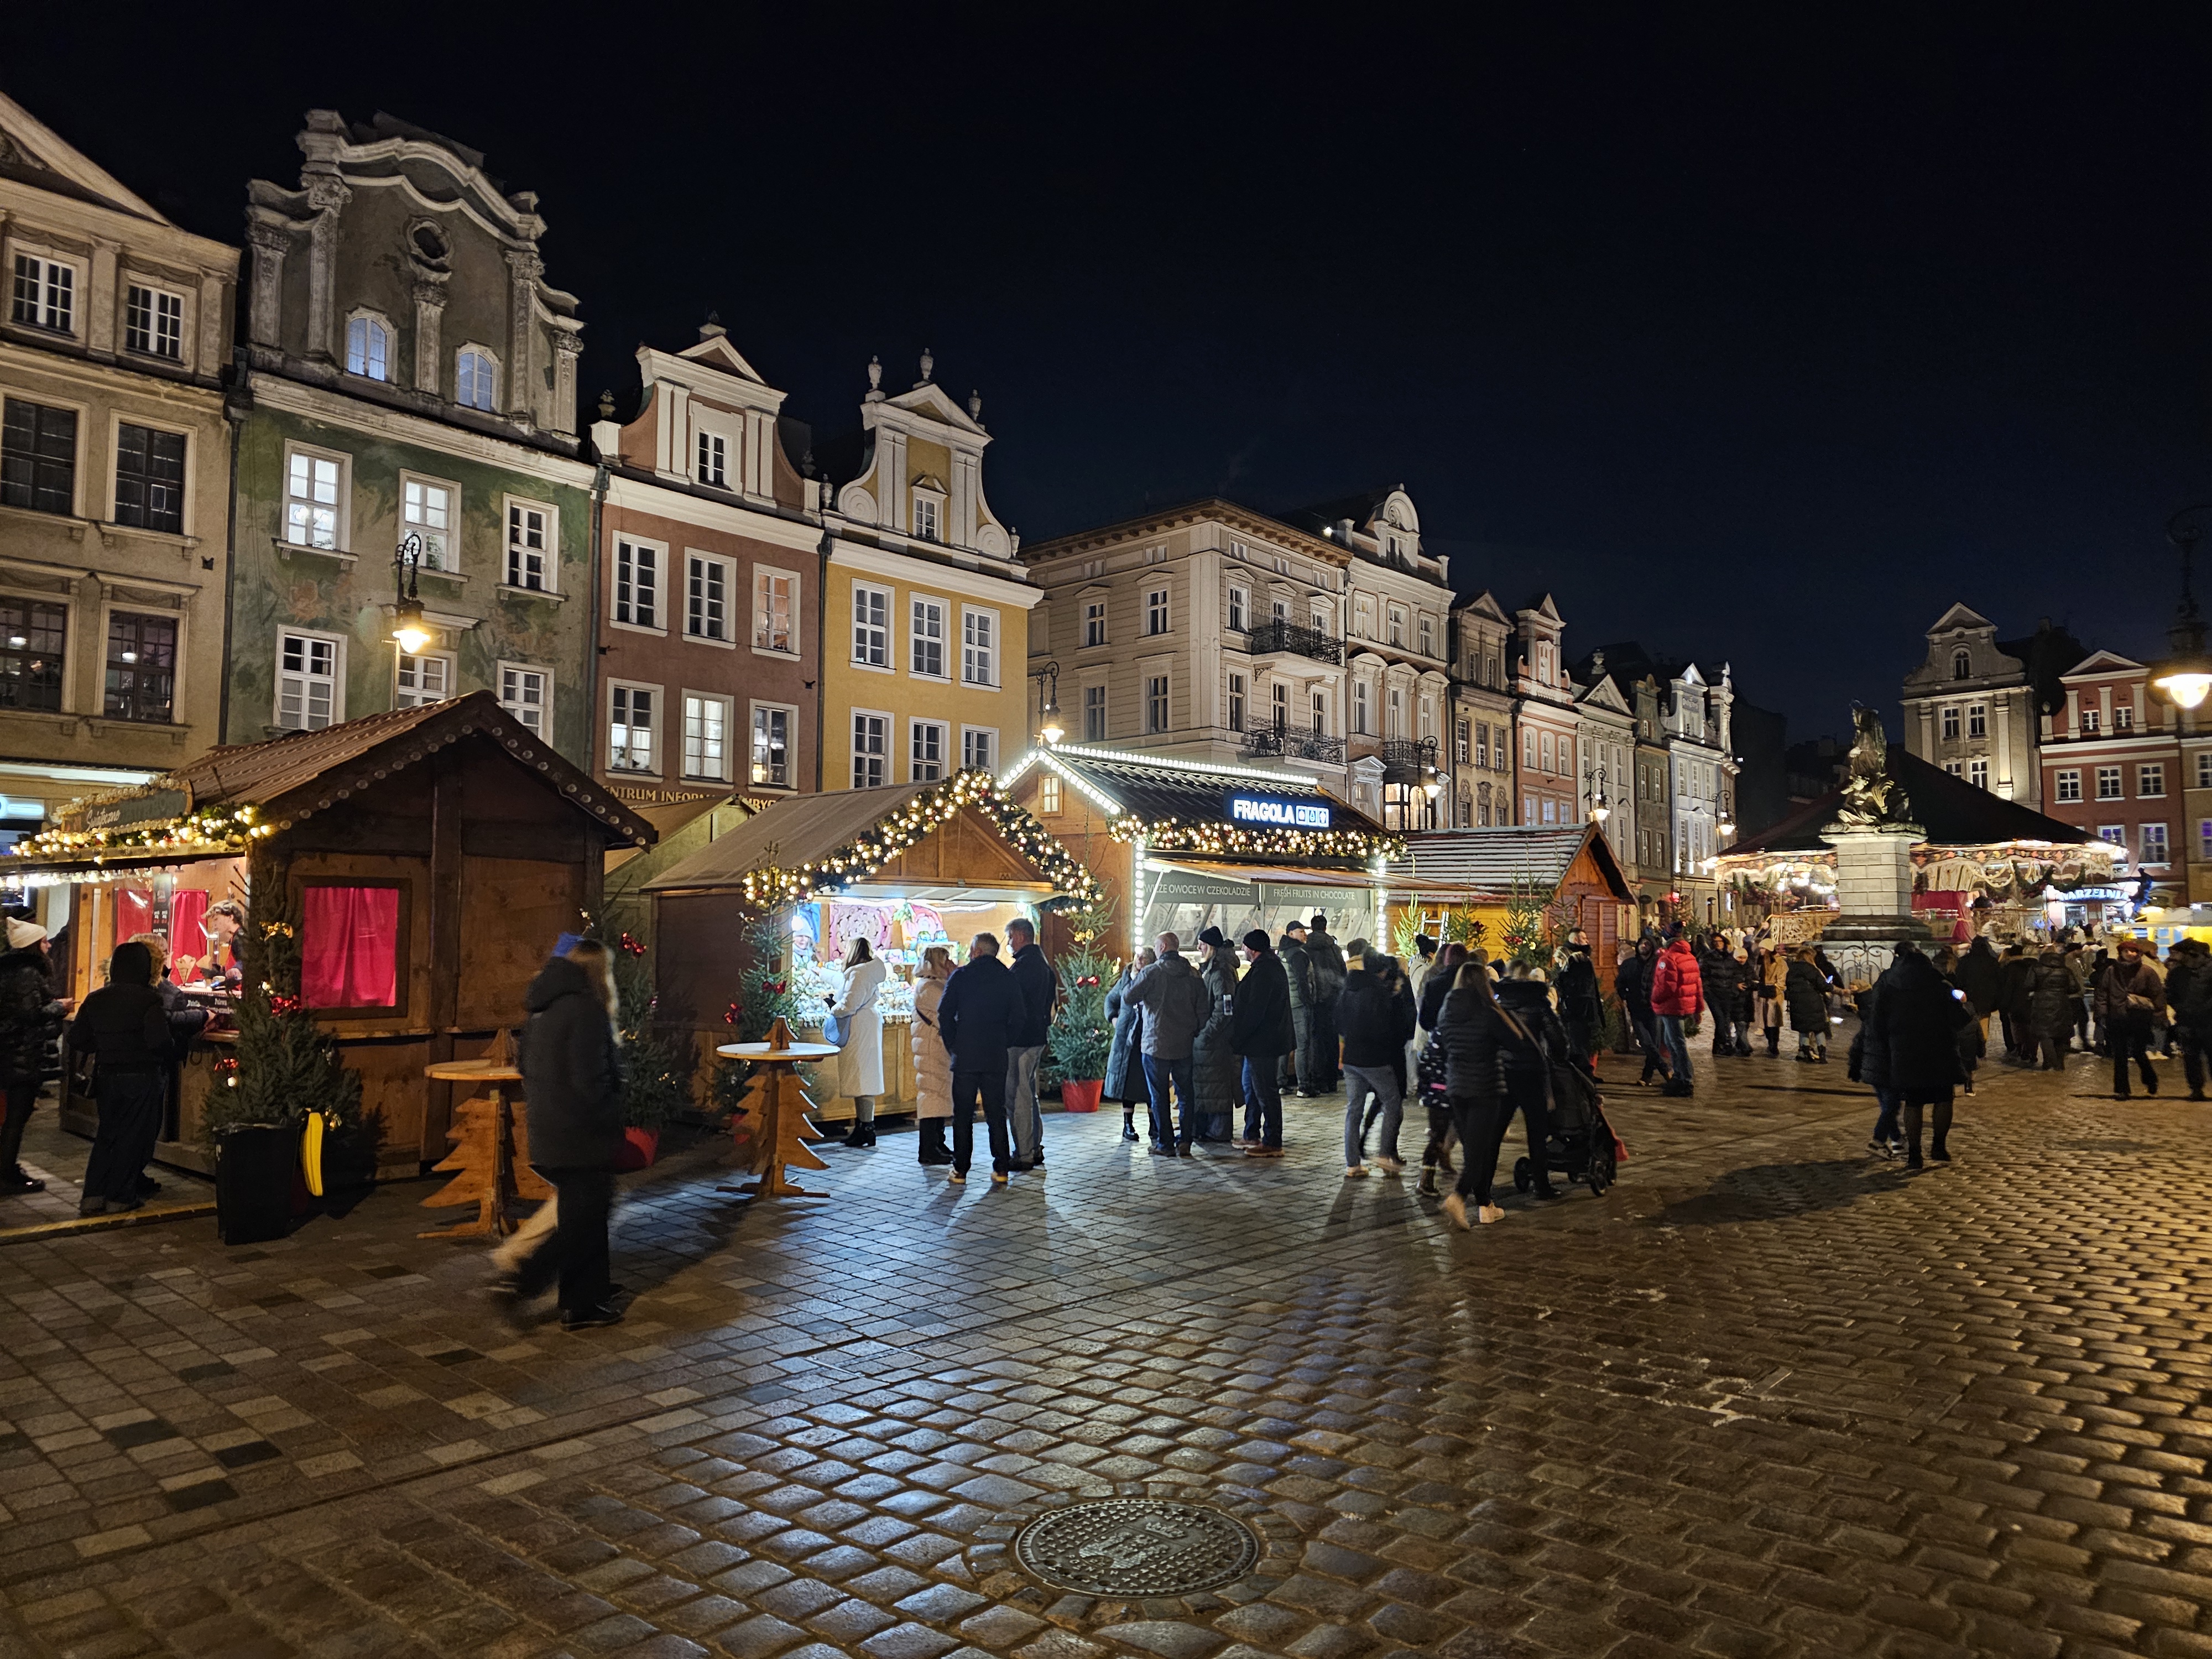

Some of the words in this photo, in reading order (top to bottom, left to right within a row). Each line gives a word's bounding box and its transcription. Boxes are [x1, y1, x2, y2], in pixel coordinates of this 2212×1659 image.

[603, 785, 656, 801] NTRUM
[1234, 799, 1295, 824] FRAGOLA
[1168, 885, 1197, 894] OWOCE
[1206, 886, 1251, 896] CZEKOLADZIE
[1273, 888, 1291, 898] FRESH
[1292, 889, 1312, 898] FRUITS
[1312, 890, 1319, 899] IN
[1320, 890, 1355, 900] CHOCOLATE
